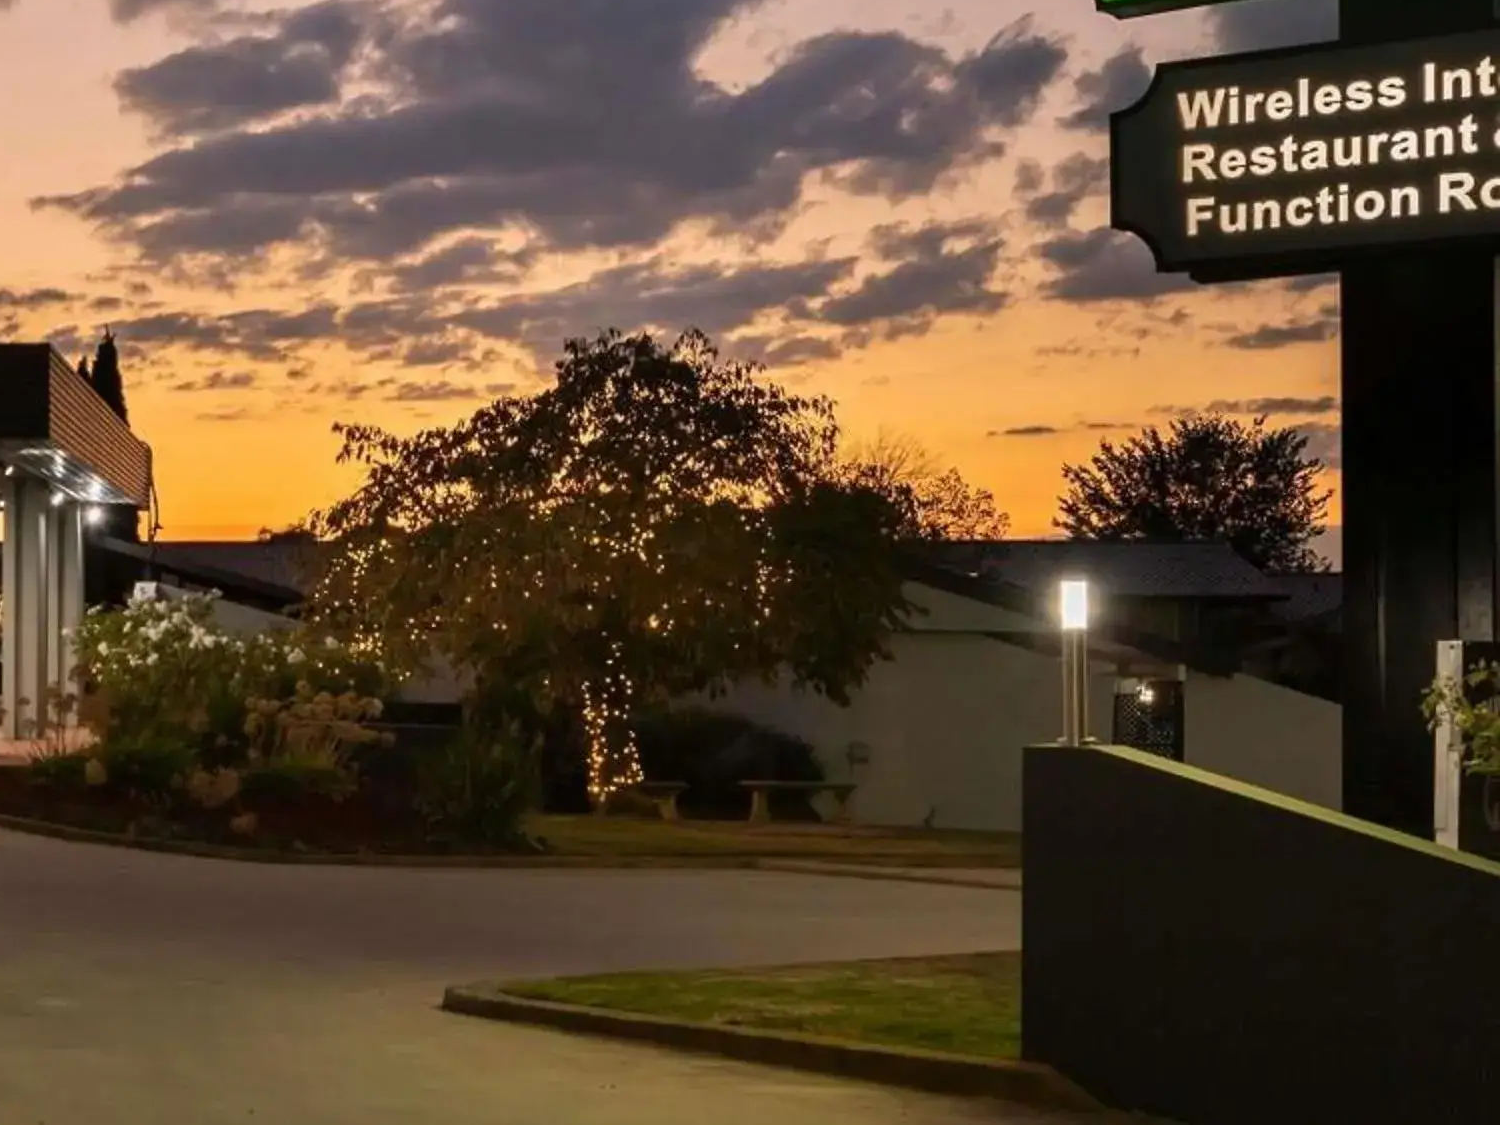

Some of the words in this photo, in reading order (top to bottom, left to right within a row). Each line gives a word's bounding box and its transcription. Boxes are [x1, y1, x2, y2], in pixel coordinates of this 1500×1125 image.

[1177, 75, 1407, 131] Wireless
[1423, 55, 1500, 104] Int
[1182, 113, 1479, 183] Restaurant
[1186, 183, 1420, 237] Function
